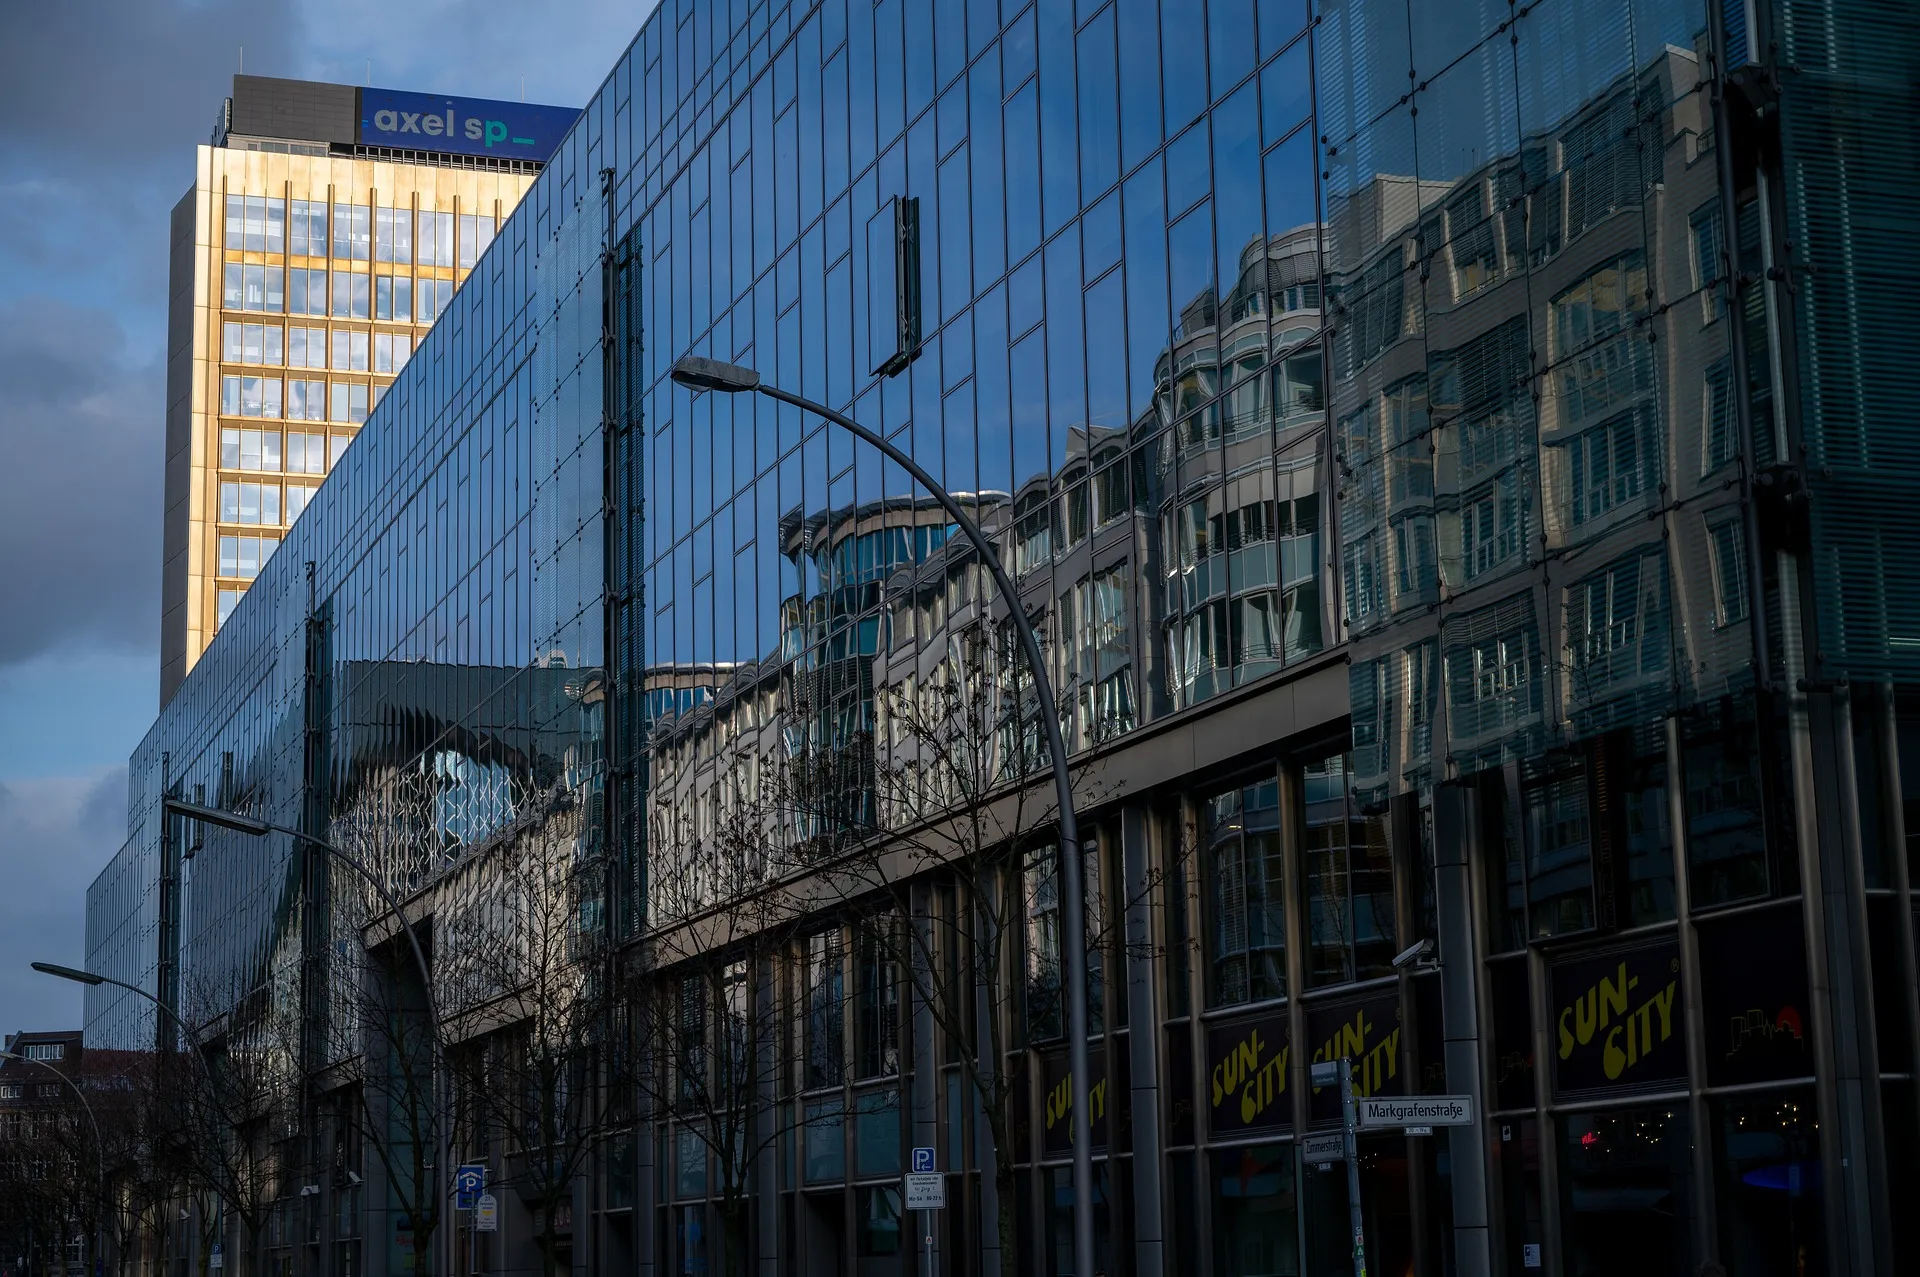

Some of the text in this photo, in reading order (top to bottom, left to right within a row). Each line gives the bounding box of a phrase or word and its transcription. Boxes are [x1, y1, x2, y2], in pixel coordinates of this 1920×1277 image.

[1558, 961, 1639, 1060] SUN-
[1603, 980, 1676, 1080] CITY
[1212, 1028, 1265, 1108] SUN-
[1241, 1045, 1289, 1125] CITY
[1368, 1102, 1463, 1120] Markgrafenstraße
[916, 1150, 930, 1170] P
[1305, 1137, 1342, 1154] Zimmerstraße
[466, 1177, 477, 1192] P
